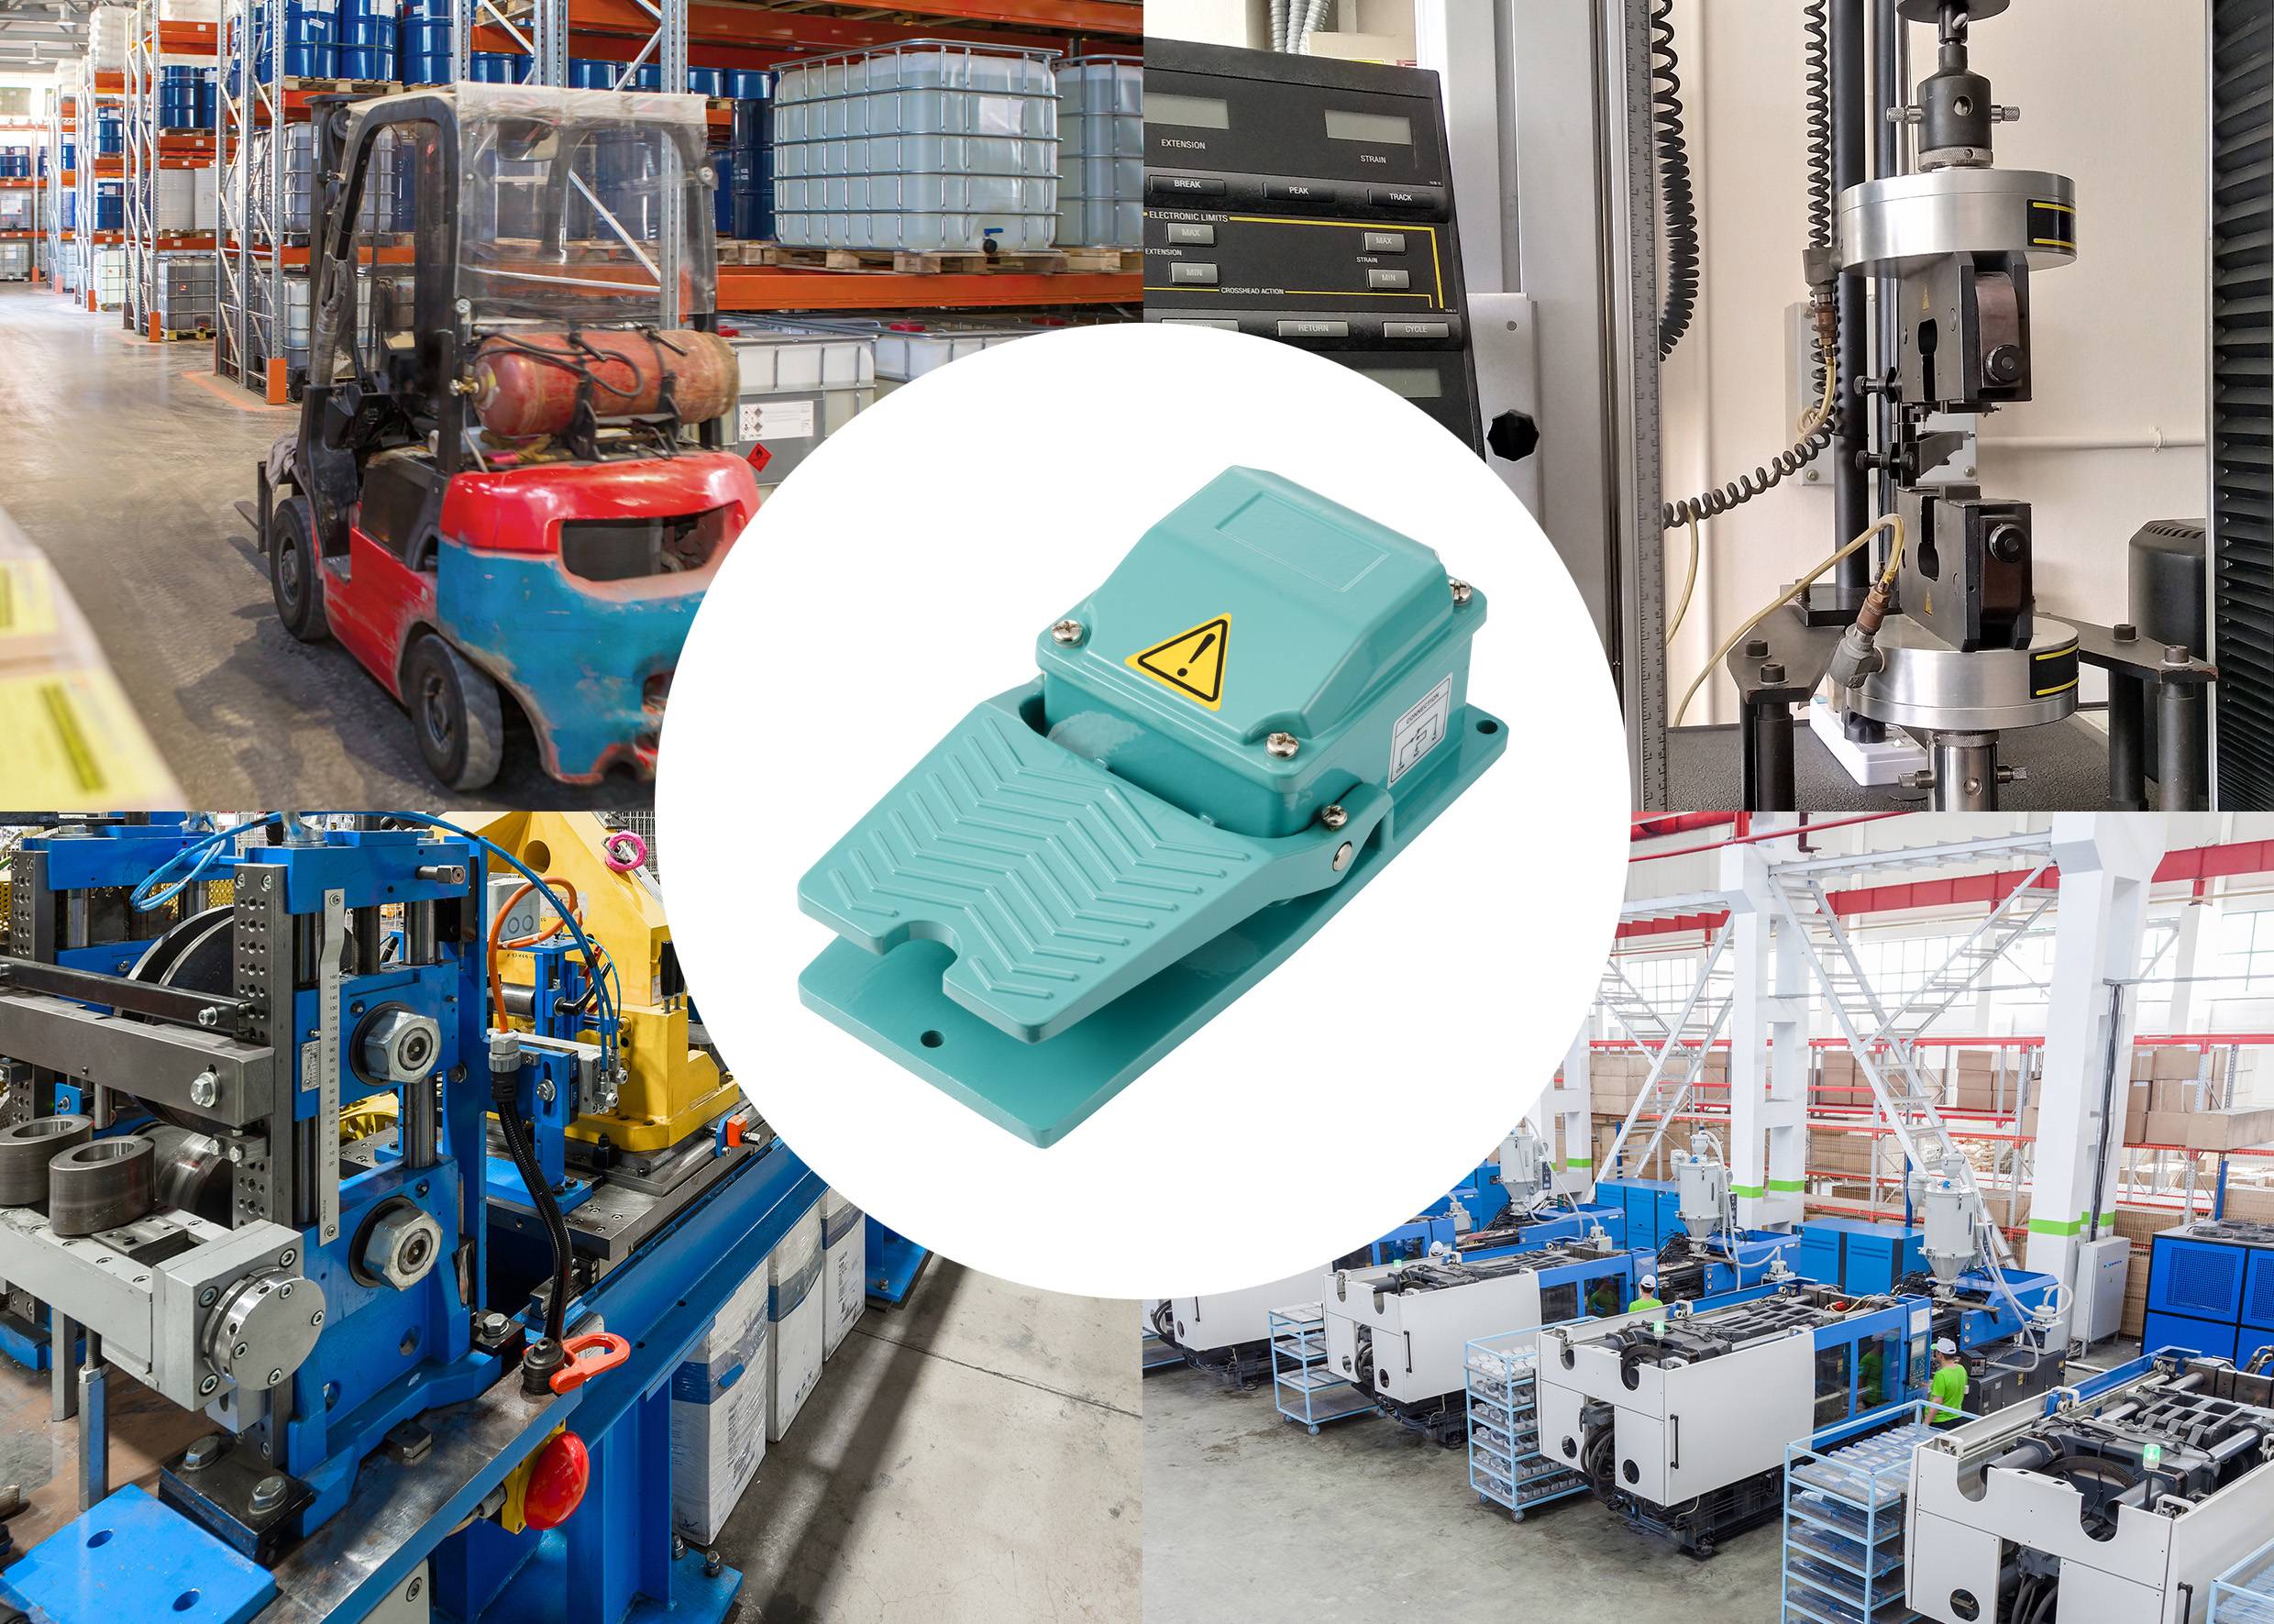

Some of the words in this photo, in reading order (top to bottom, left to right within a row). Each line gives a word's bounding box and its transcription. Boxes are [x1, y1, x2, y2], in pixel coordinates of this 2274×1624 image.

[1161, 138, 1206, 150] EXTENSION
[1360, 155, 1387, 164] STRAIN
[1174, 180, 1201, 189] BREAK
[1288, 186, 1309, 195] PEAK
[1388, 193, 1413, 202] TRACK
[1149, 211, 1199, 221] ELECTRONIC
[1200, 214, 1229, 223] LIMITS
[1181, 228, 1200, 238] MAX
[1375, 237, 1393, 245] MAX
[1145, 249, 1183, 257] EXTENSION
[1186, 269, 1203, 277] MIN
[1381, 273, 1396, 282] MIN
[1298, 324, 1330, 333] RETURN
[1405, 324, 1429, 333] CYCLE
[1406, 692, 1440, 724] CONNECTION
